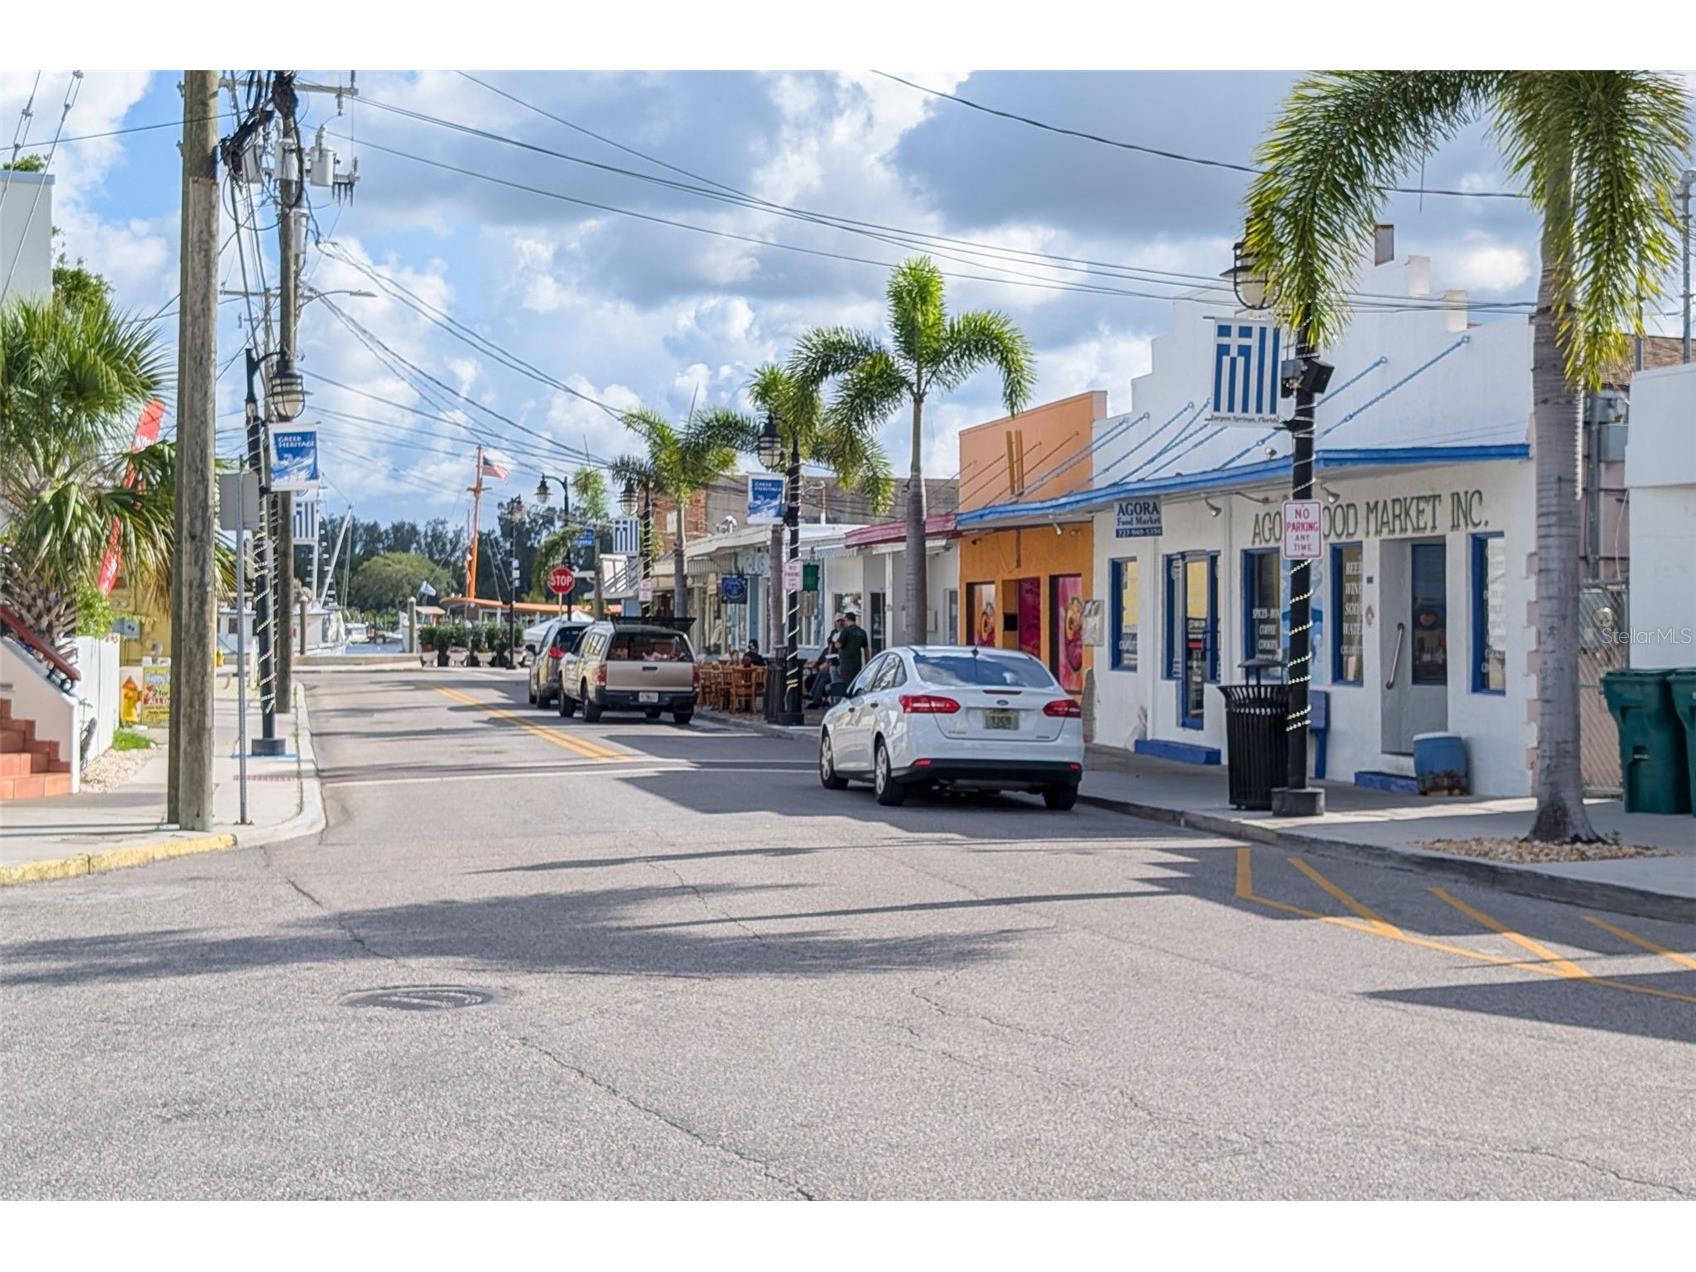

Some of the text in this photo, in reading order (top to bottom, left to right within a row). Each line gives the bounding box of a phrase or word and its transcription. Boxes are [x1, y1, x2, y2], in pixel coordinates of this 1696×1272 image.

[1116, 501, 1160, 517] AGORA
[1294, 508, 1311, 520] NO
[1116, 516, 1161, 526] Food Market
[1251, 489, 1489, 546] AGO OOD MARKET INC.
[1286, 521, 1319, 533] PARKING
[1295, 534, 1310, 542] ANY
[1294, 543, 1312, 552] TIME
[549, 574, 573, 587] STOP
